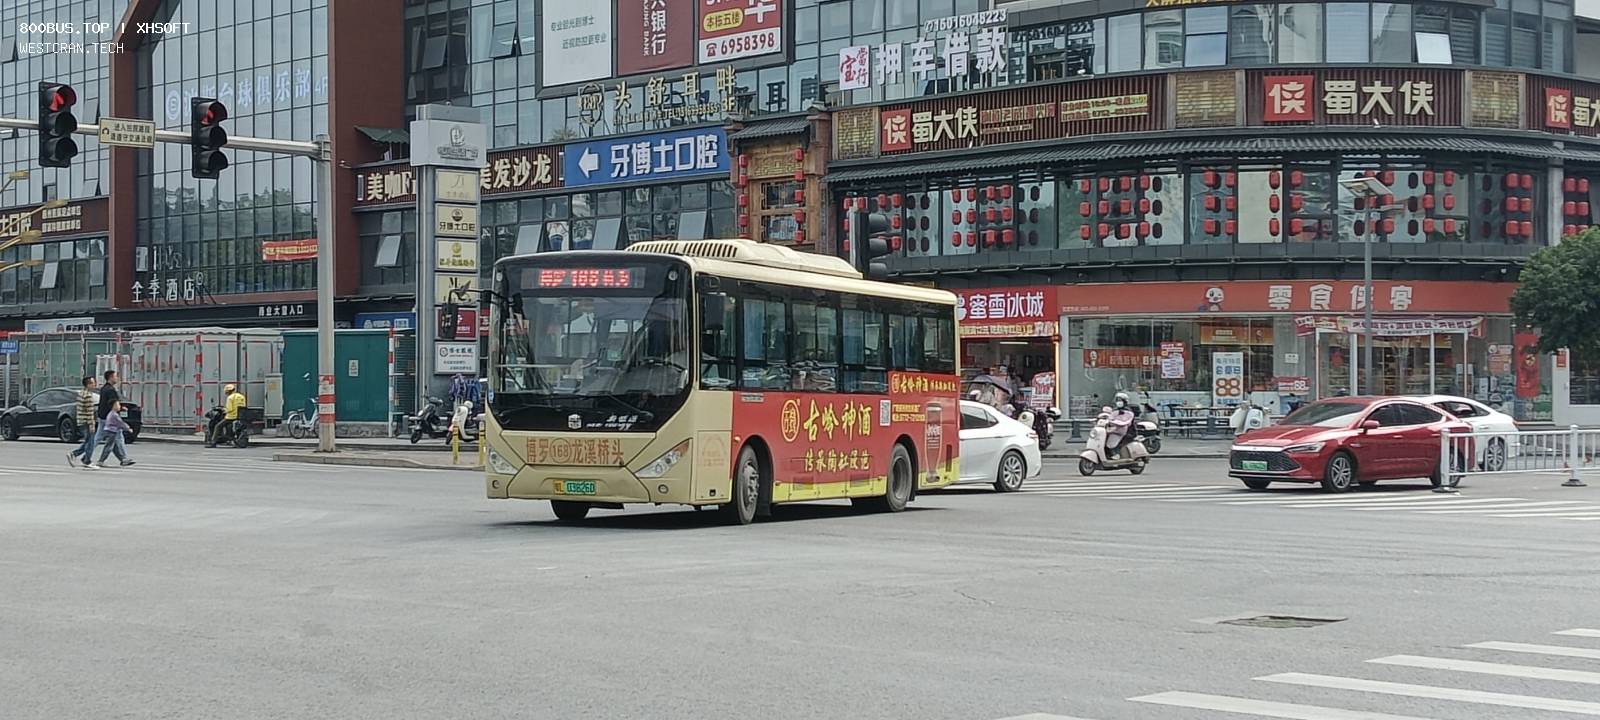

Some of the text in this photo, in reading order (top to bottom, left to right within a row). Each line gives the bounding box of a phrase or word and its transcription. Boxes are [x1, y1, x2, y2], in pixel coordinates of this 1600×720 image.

[934, 8, 1006, 31] 15016048223
[721, 32, 774, 55] 6958398
[876, 26, 1006, 85] 押车借款
[614, 64, 736, 110] 头舒耳畔
[722, 97, 736, 112] 3F
[1323, 80, 1434, 115] 蜀大侠
[912, 106, 978, 143] 蜀大侠
[480, 154, 551, 190] 美发沙龙
[609, 135, 718, 178] 牙博士口腔
[131, 274, 195, 303] 全季酒店
[969, 292, 1044, 319] 蜜雪冰城
[804, 399, 872, 441] 古岭神酒
